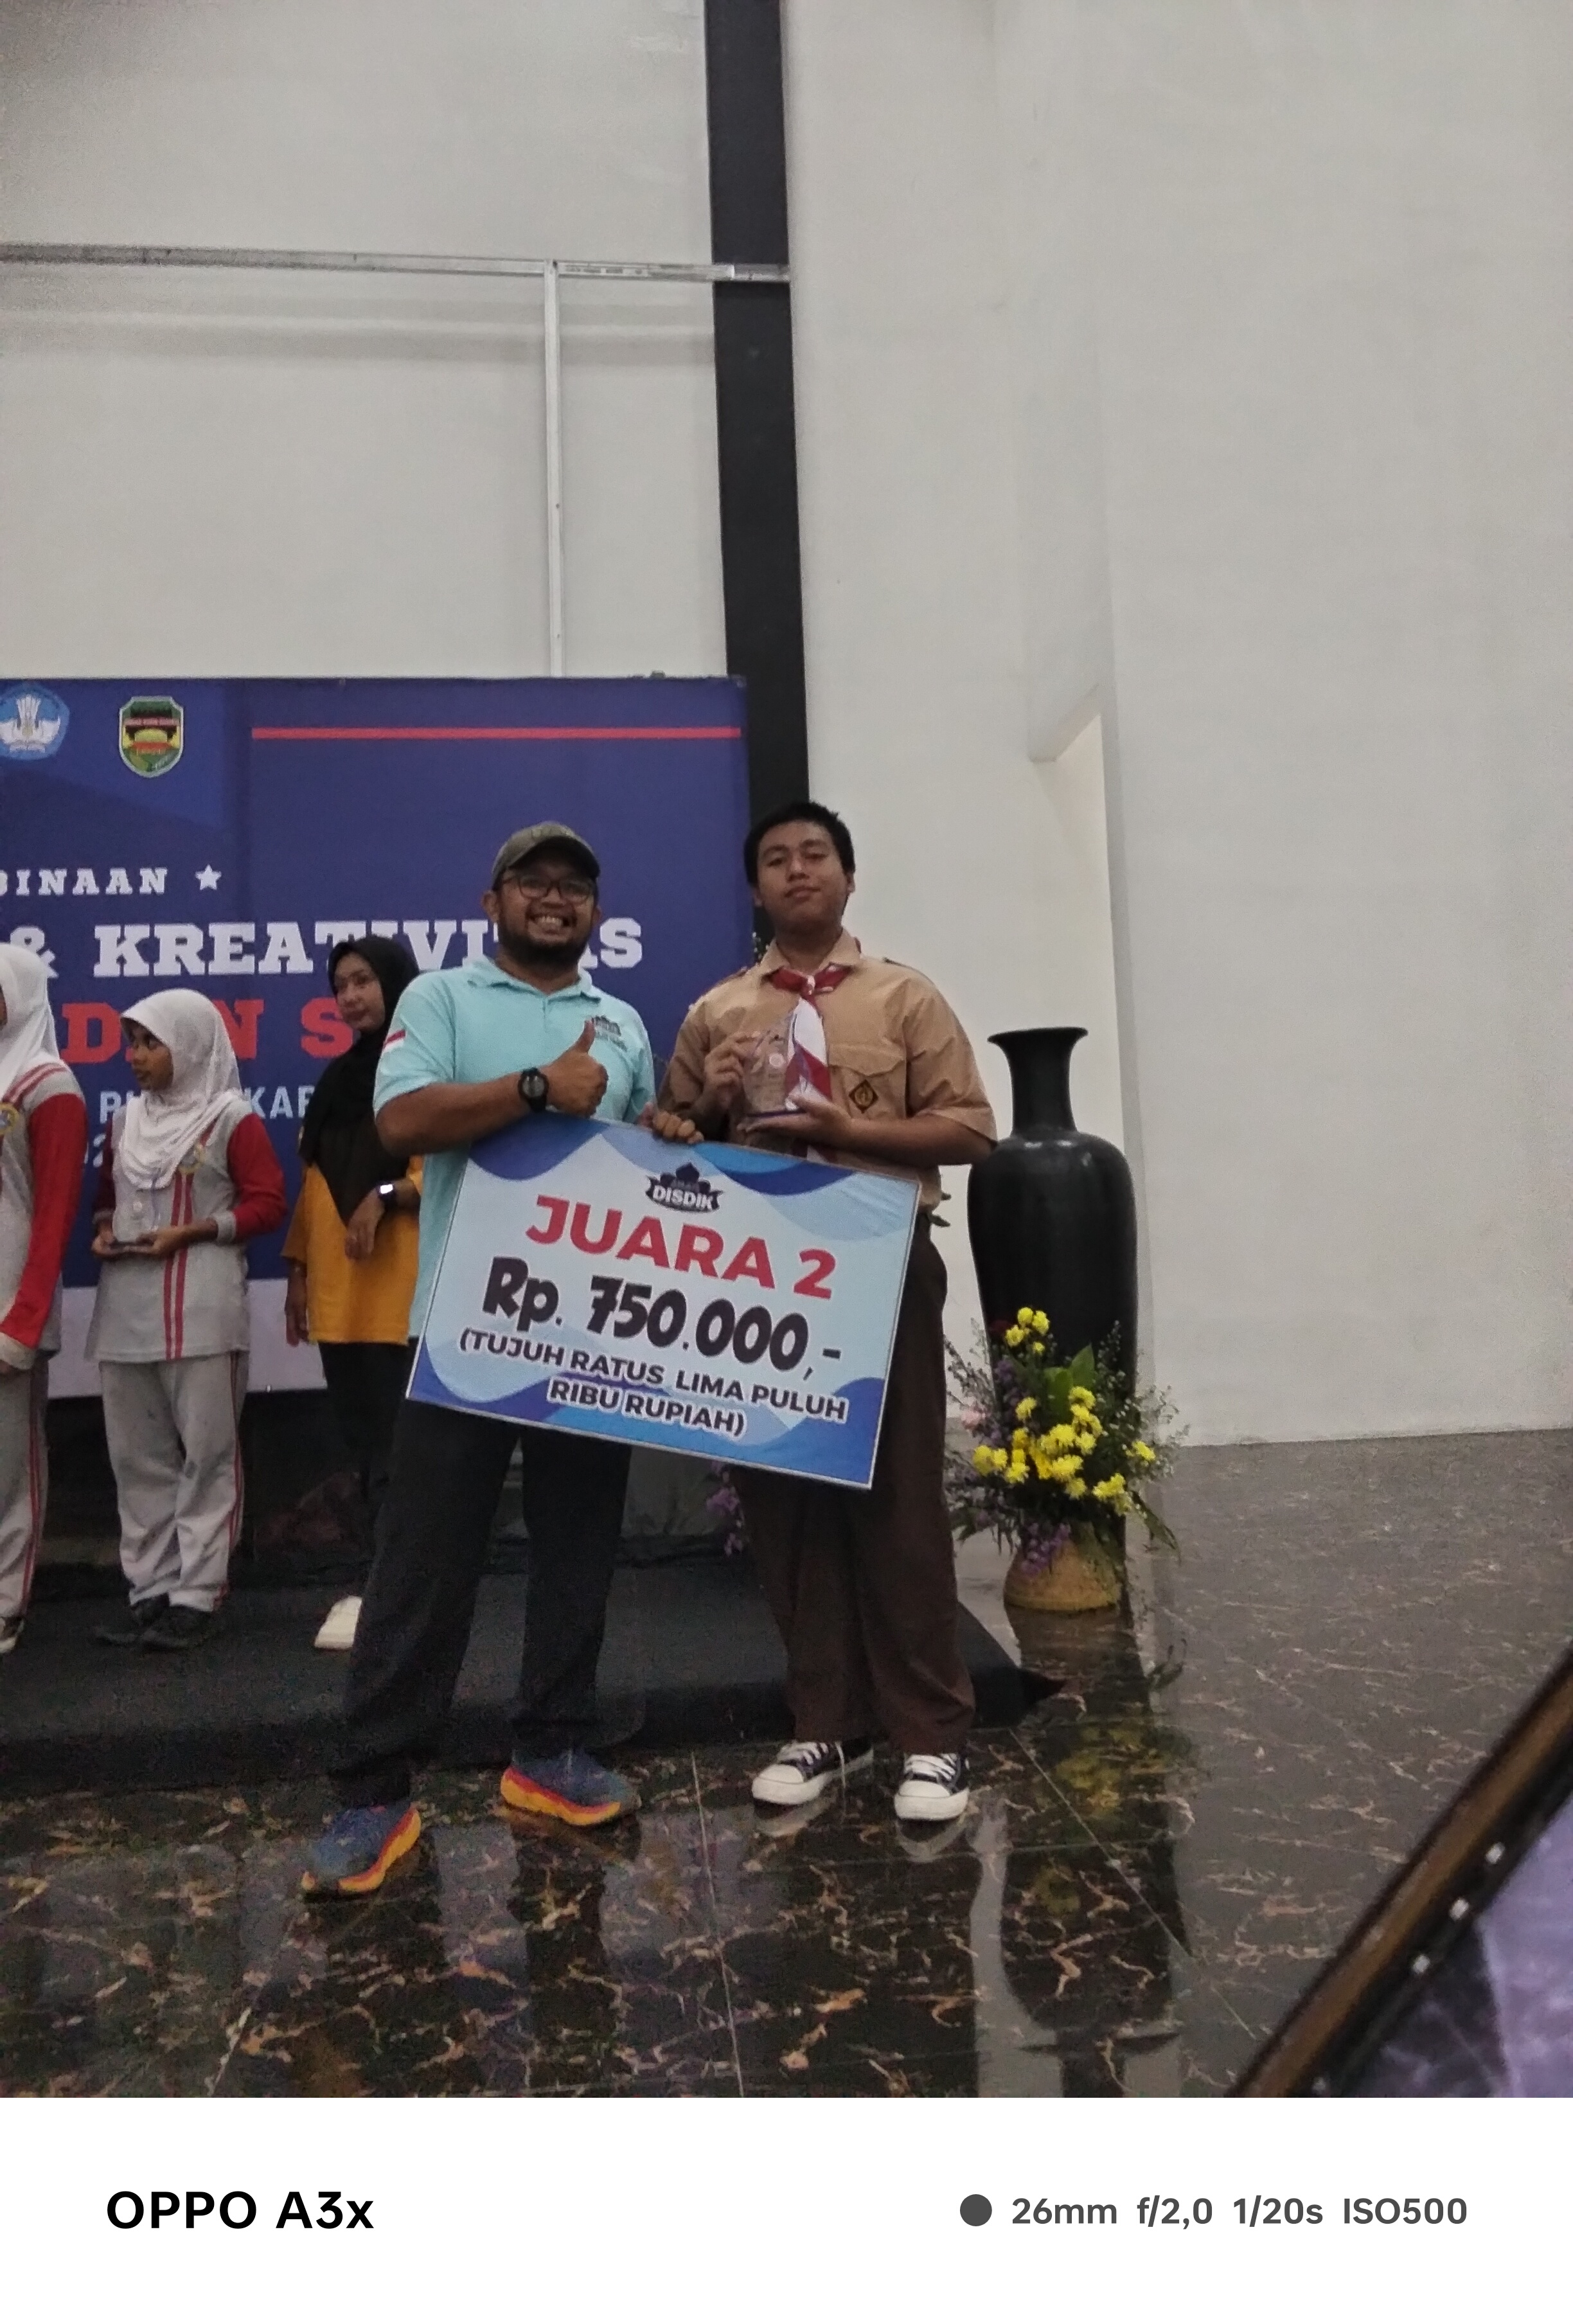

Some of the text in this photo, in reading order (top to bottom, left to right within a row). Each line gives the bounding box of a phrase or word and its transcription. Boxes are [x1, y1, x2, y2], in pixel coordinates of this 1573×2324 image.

[653, 1184, 713, 1211] DISDIK
[526, 1195, 836, 1299] JUARA 2
[482, 1256, 841, 1381] Rp. 750.000,-
[460, 1327, 847, 1420] (TUJUH RATUS LIMA PULUH
[550, 1379, 745, 1437] RIBU RUPIAH)
